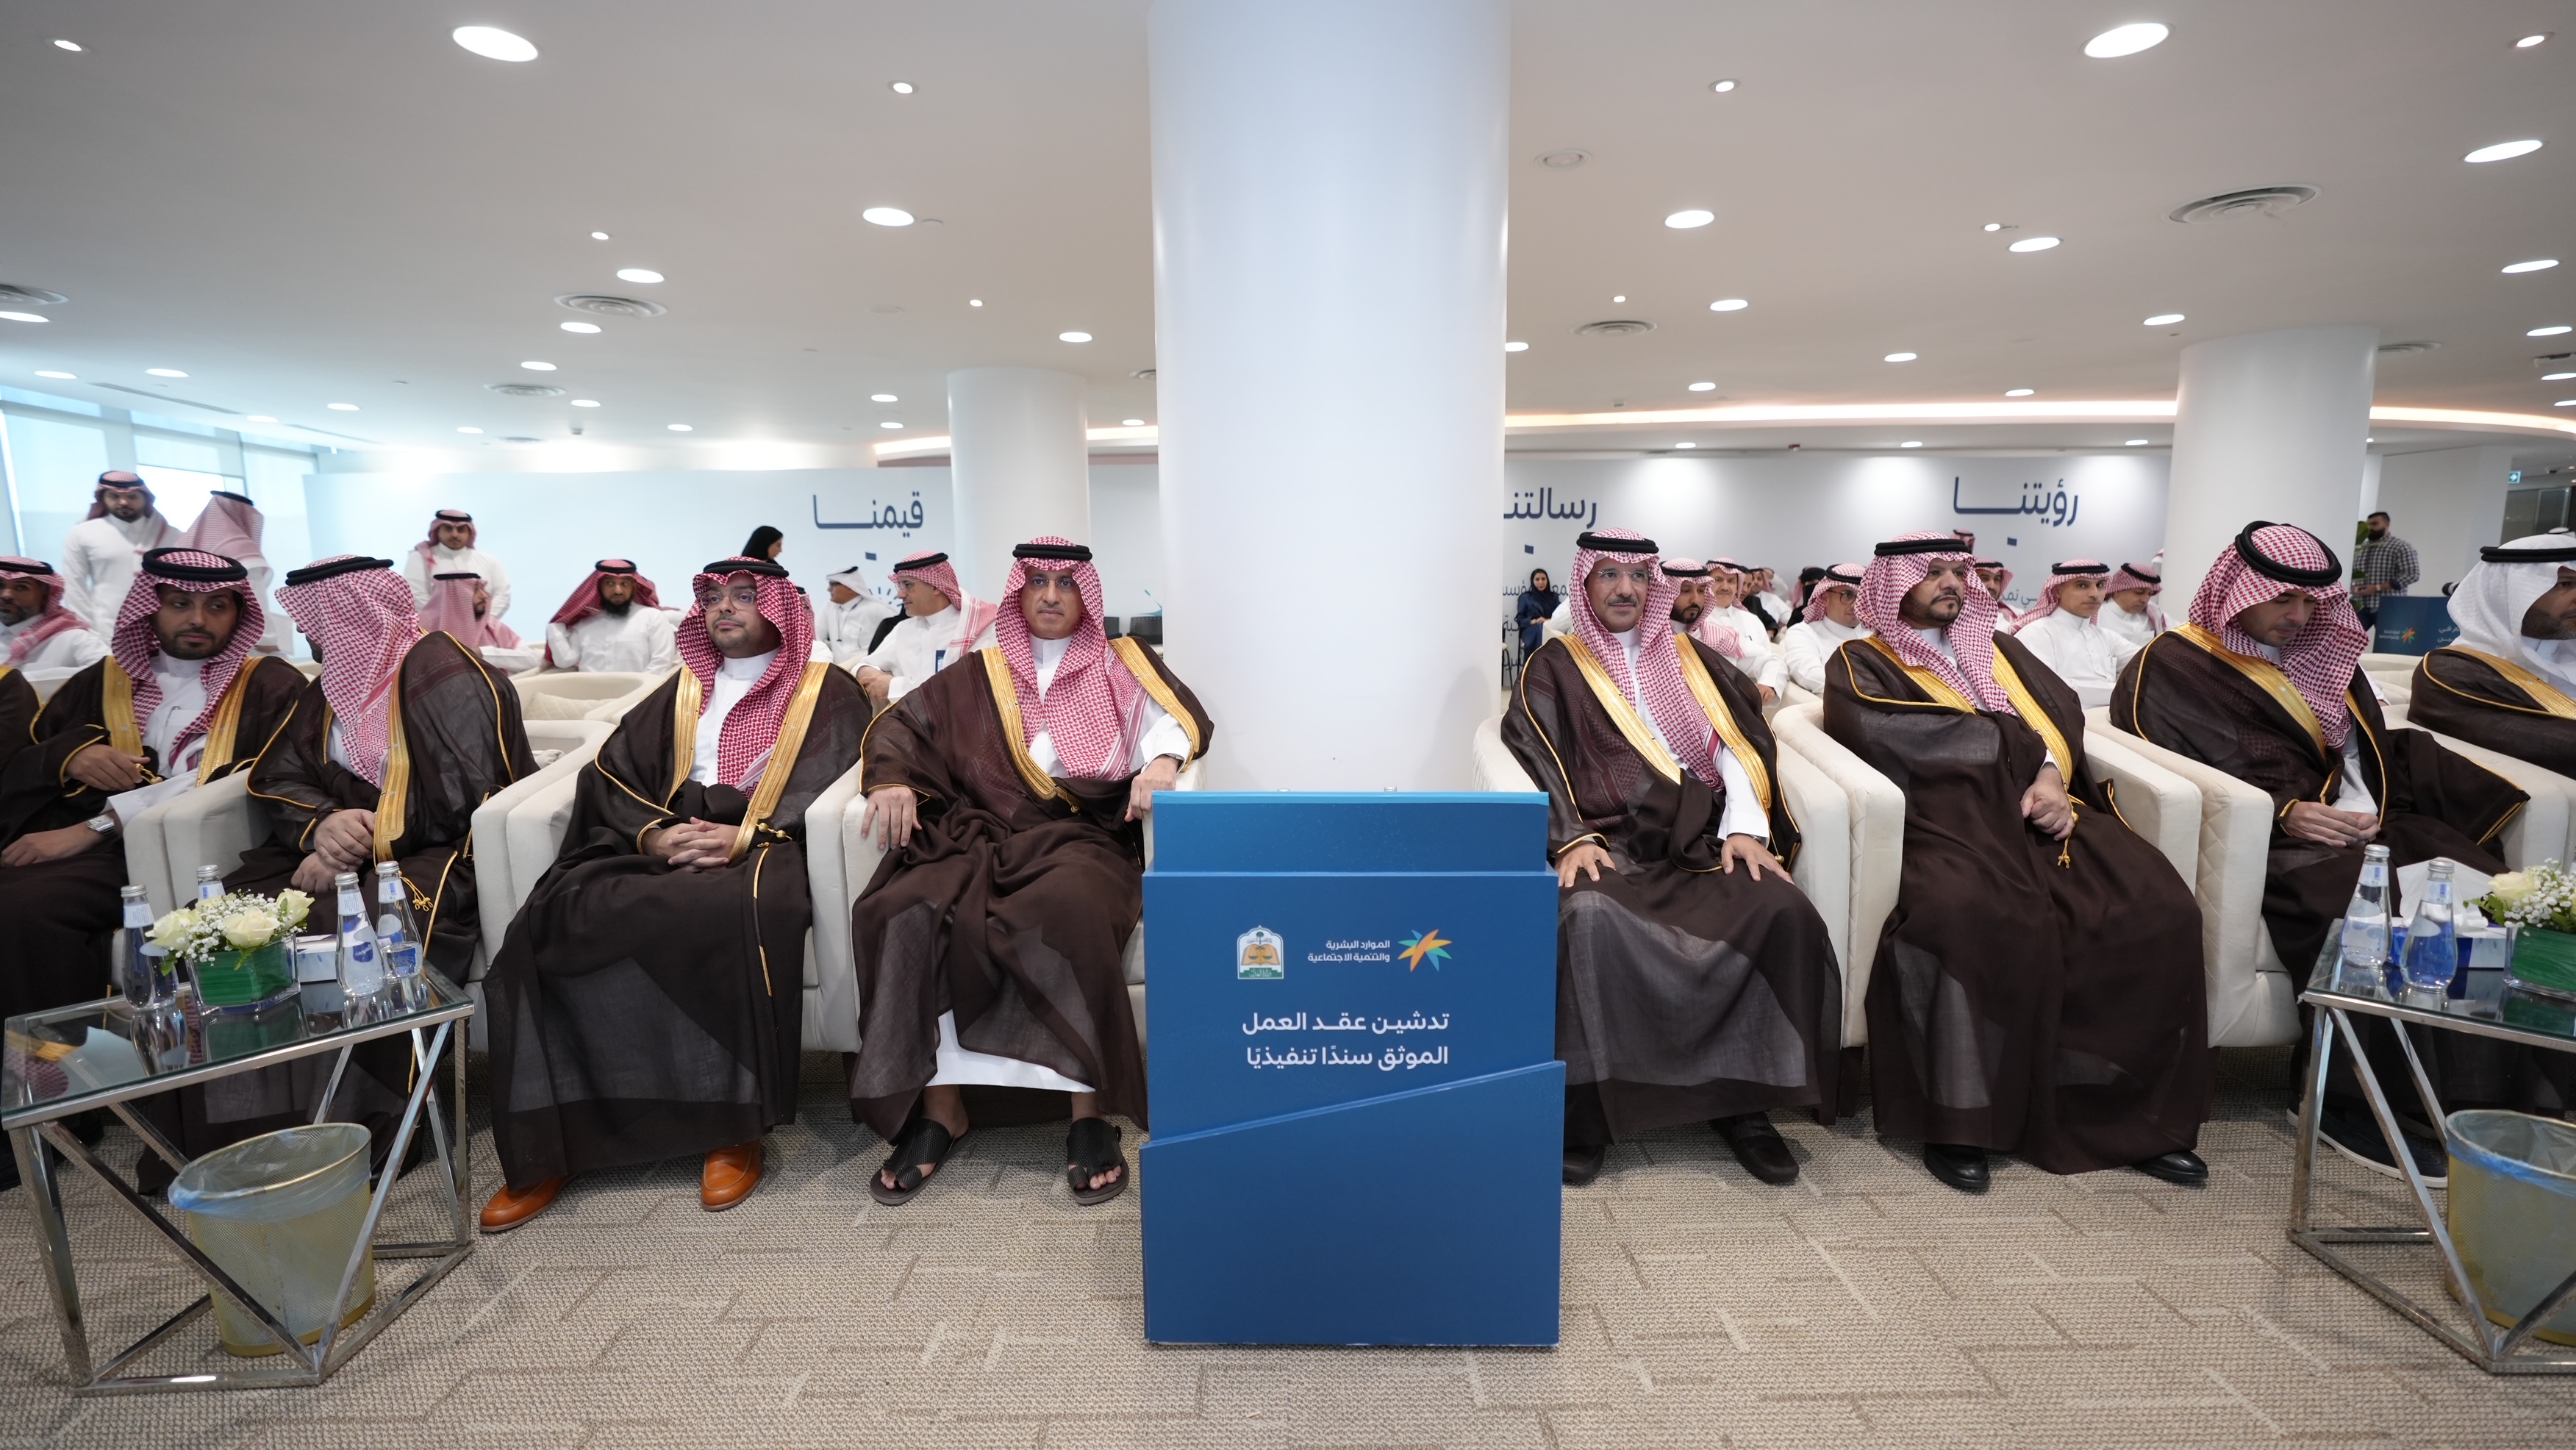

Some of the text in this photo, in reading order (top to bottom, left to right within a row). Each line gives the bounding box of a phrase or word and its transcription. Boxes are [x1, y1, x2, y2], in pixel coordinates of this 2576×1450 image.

[812, 491, 924, 538] قيمنا
[1503, 487, 1598, 529] رسالتن
[1953, 476, 2079, 527] رؤيتنا
[1307, 953, 1390, 964] والتنمية الاجتماعية
[1325, 940, 1390, 951] الموارد البشرية
[1242, 1010, 1450, 1036] تدشين عقد العمل
[1246, 1045, 1448, 1071] الموثق سندًا تنفيذيًا
